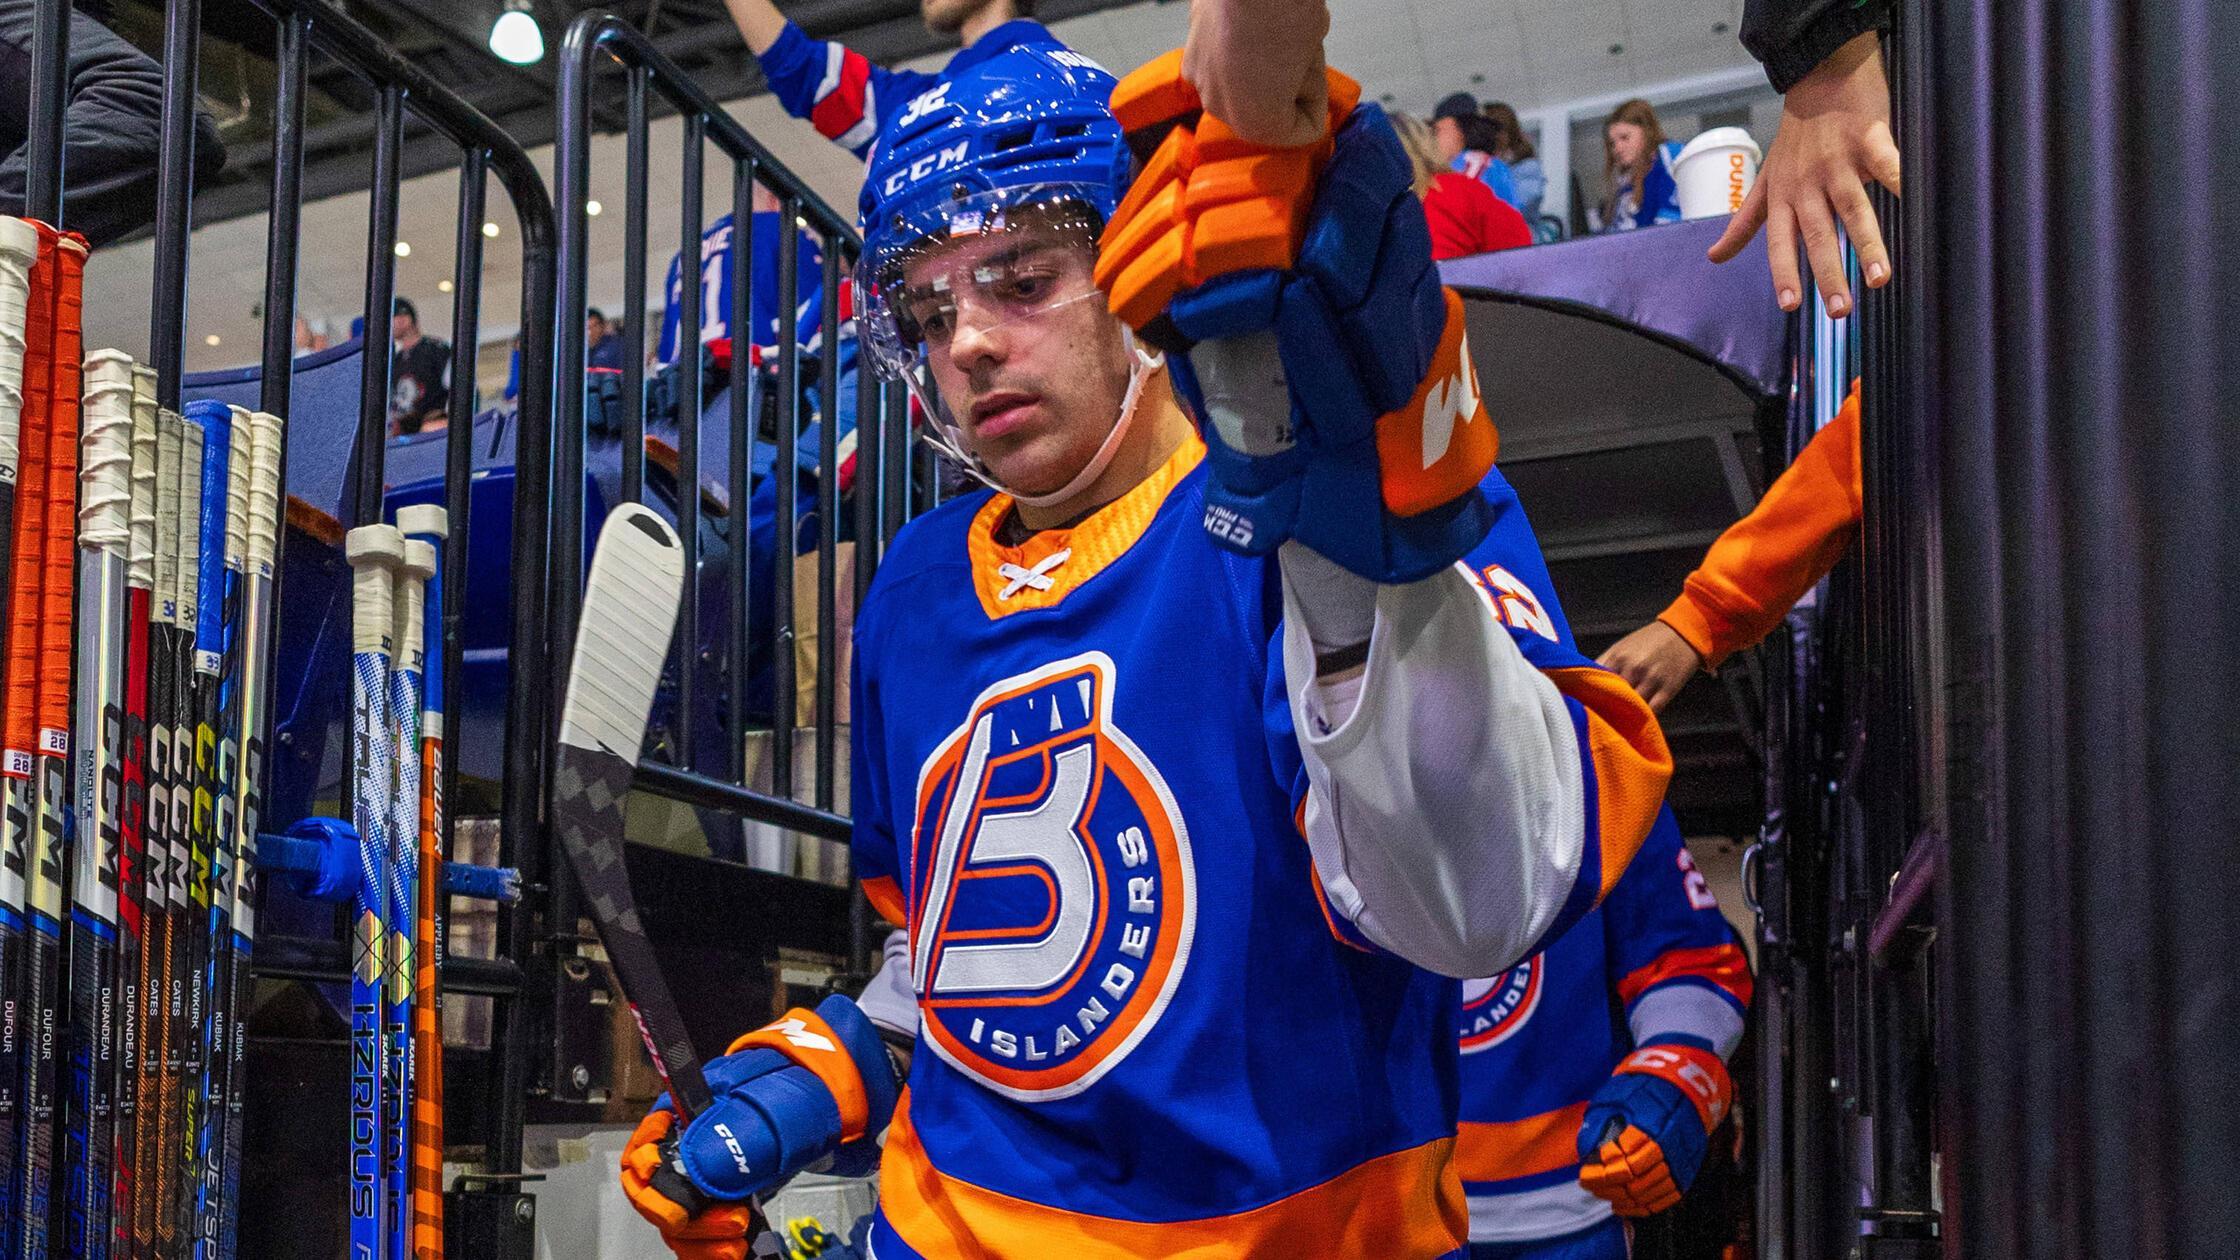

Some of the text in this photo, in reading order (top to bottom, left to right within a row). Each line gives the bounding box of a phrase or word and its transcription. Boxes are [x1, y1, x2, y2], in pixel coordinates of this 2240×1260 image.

[885, 141, 969, 196] CCM
[1203, 513, 1253, 548] CCM
[13, 758, 29, 773] 28
[50, 736, 66, 750] 28
[356, 692, 370, 843] TRUE
[86, 750, 95, 819] NANOLITE
[98, 702, 122, 893] CCM
[122, 711, 146, 908] CCM
[146, 722, 170, 909] CCM
[168, 724, 193, 909] CCM
[190, 721, 216, 909] CCM
[214, 736, 238, 916] CCM
[238, 735, 262, 907] CCM
[435, 912, 443, 969] APPLEBY
[969, 826, 1155, 1061] ISLANDERS
[3, 1001, 14, 1053] DUFOUR
[101, 988, 110, 1060] DURANDEAU
[125, 986, 135, 1069] DURANDEAU
[150, 979, 159, 1016] CATES
[172, 980, 181, 1017] CATES
[191, 970, 200, 1029] NEWKIRK
[42, 1009, 53, 1060] DUFOUR
[213, 1012, 223, 1053] KUBIAK
[235, 1022, 244, 1061] KUBIAK
[185, 1088, 196, 1161] SUPER
[352, 1003, 375, 1219] HZRDUS
[713, 1123, 750, 1174] CCM
